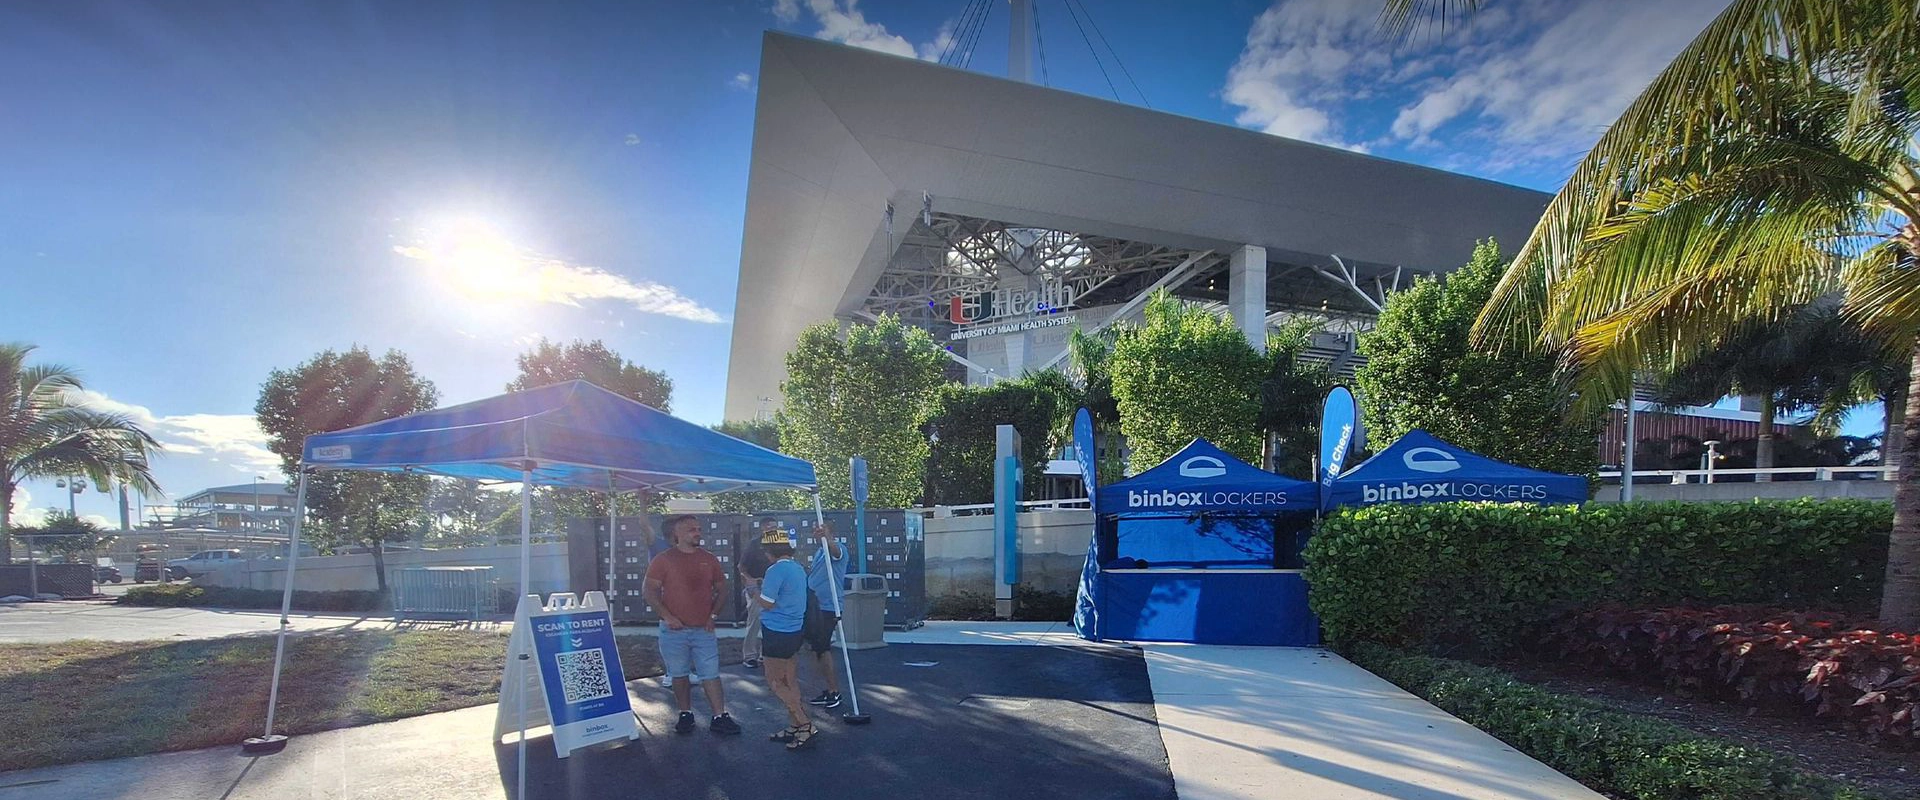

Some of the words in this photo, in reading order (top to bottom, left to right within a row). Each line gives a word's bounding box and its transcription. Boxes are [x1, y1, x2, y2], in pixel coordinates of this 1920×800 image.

[950, 328, 987, 341] UNIVERSITY
[988, 327, 997, 335] OF
[997, 323, 1020, 334] MIAMI
[1020, 319, 1047, 330] HEALTH
[1047, 316, 1076, 327] SYSTEM
[1323, 462, 1340, 487] Bag
[1332, 423, 1352, 462] Check
[537, 622, 566, 632] SCAN
[566, 620, 580, 629] TO
[581, 618, 606, 627] RENT
[586, 724, 609, 733] binbox
